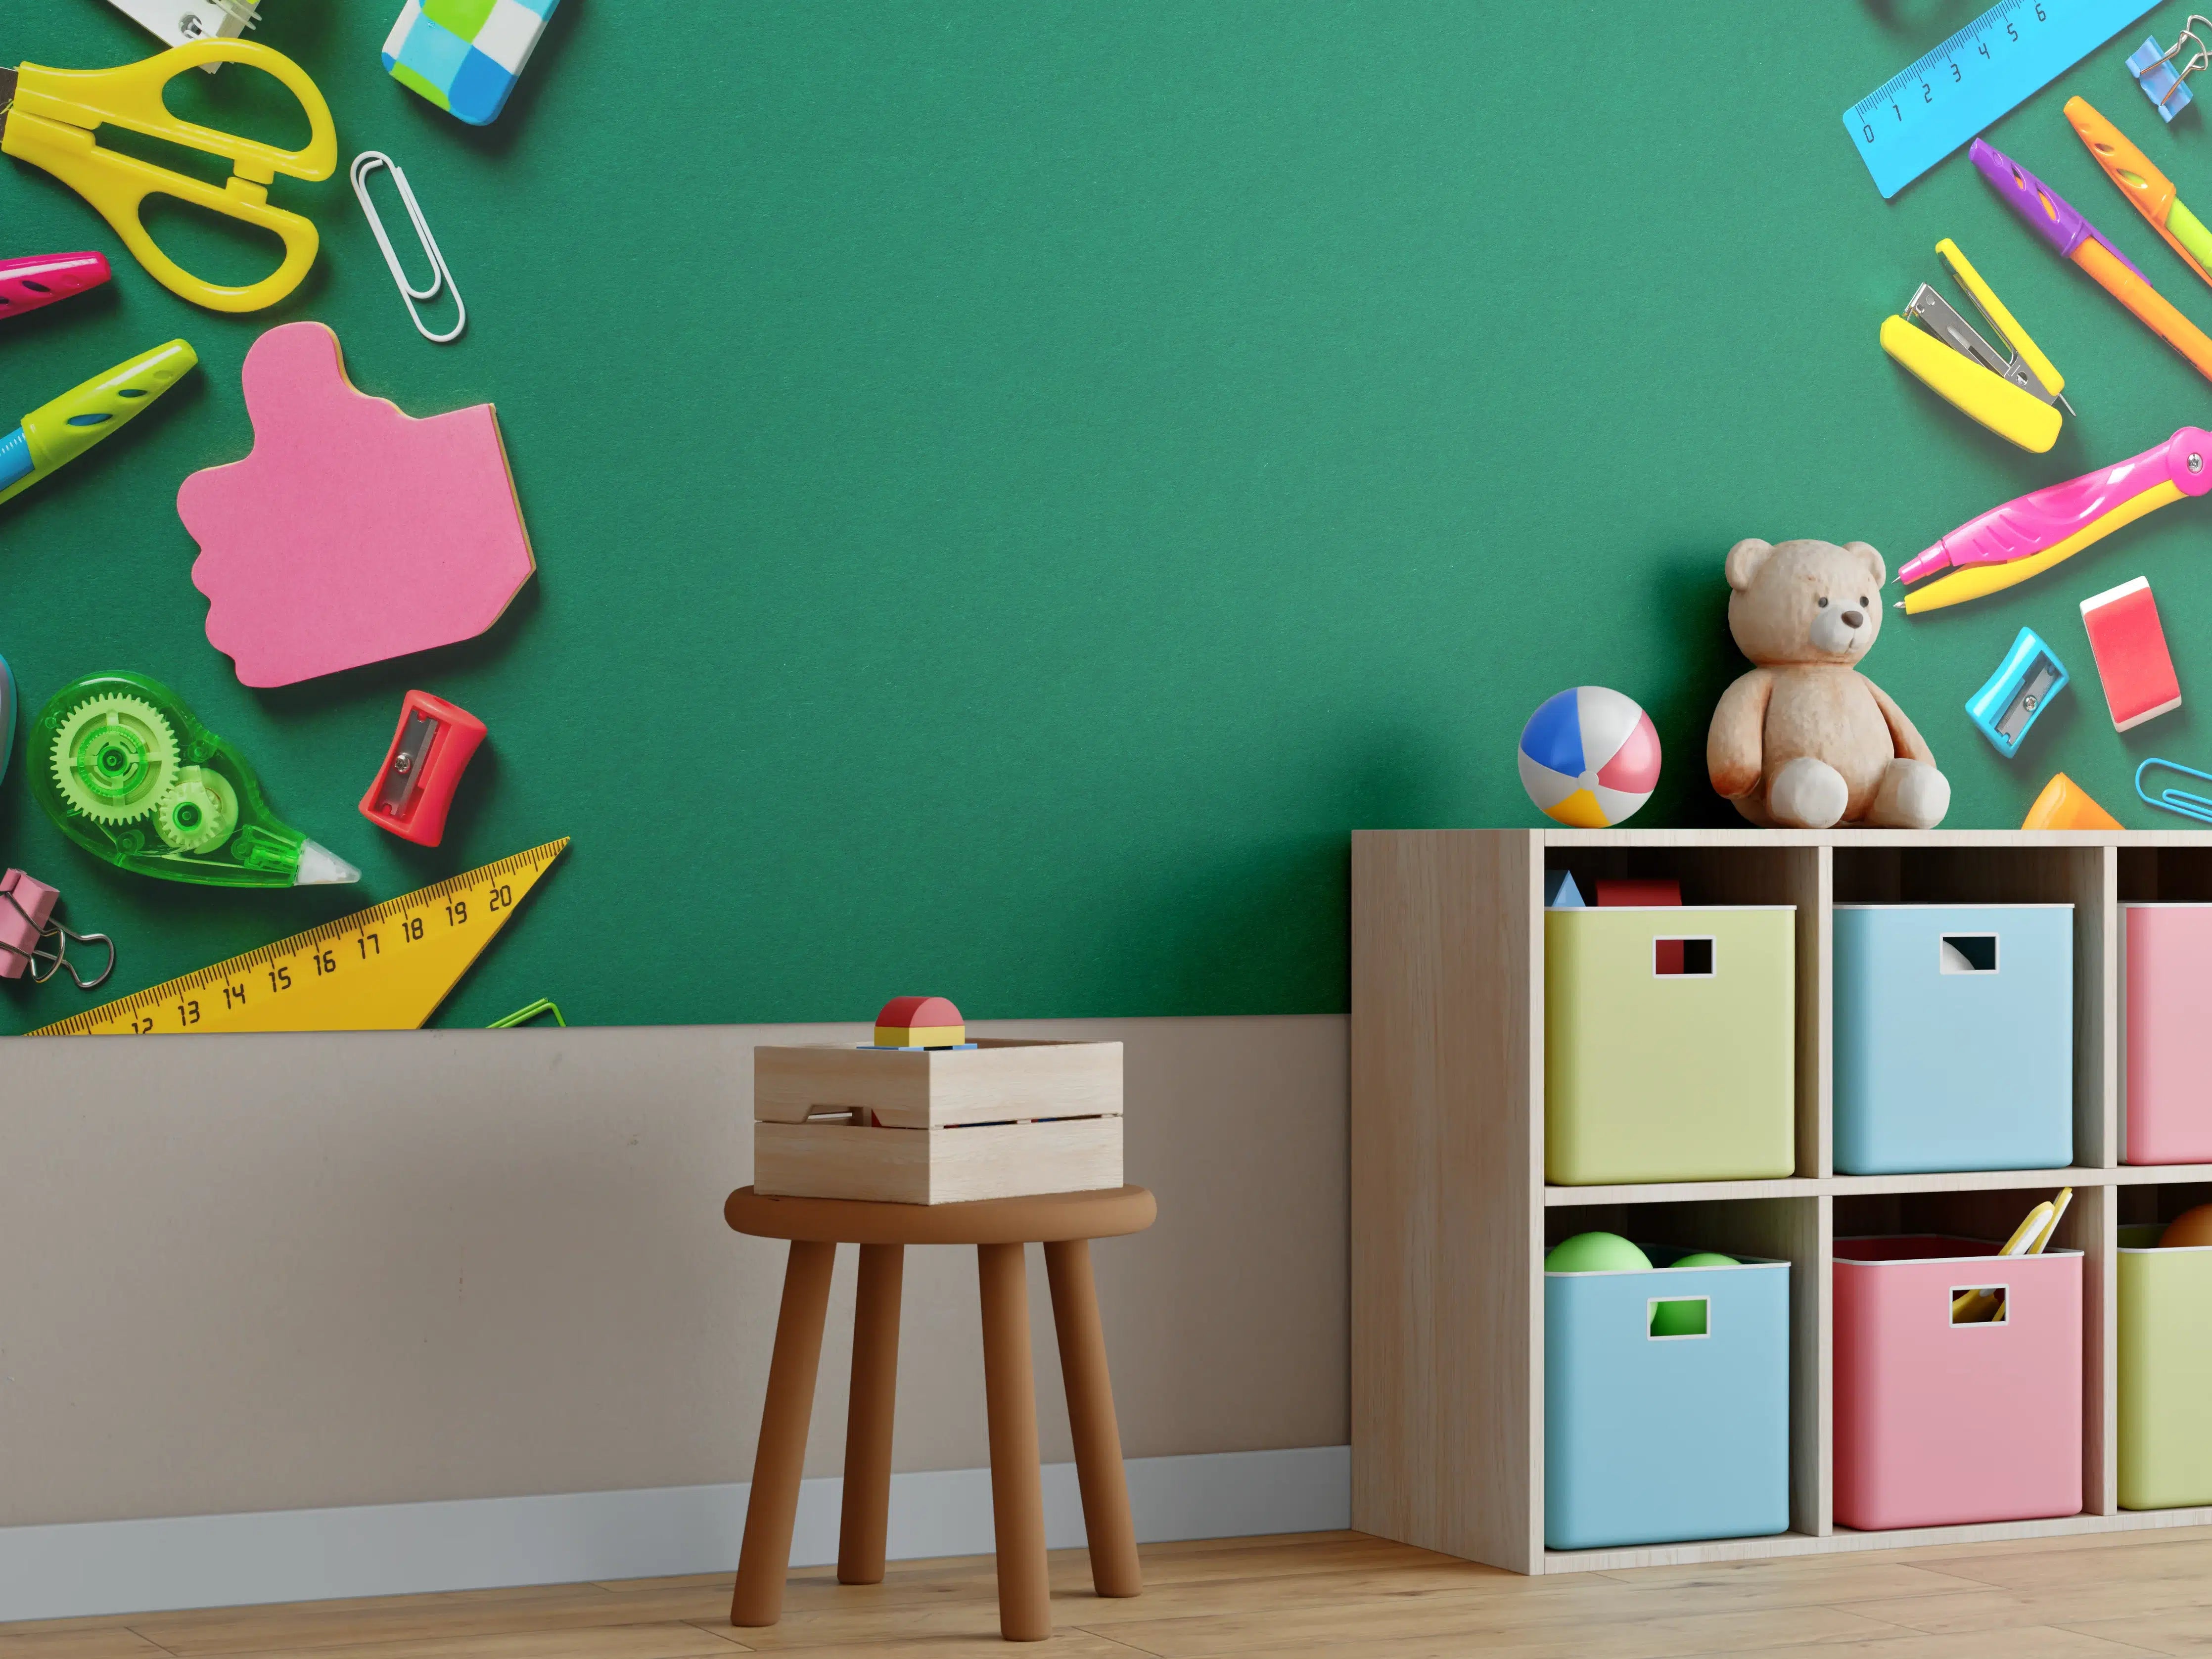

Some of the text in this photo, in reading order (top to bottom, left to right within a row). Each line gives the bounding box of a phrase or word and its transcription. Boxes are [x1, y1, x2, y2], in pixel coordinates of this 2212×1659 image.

[1863, 3, 2046, 143] 0 1 2 3 4 5 6
[178, 1001, 200, 1026] 13
[223, 983, 245, 1010] 14
[269, 967, 291, 992] 15
[313, 950, 336, 976] 16
[358, 933, 379, 959] 17
[402, 918, 423, 943] 18
[446, 902, 467, 926] 19
[489, 885, 511, 912] 20
